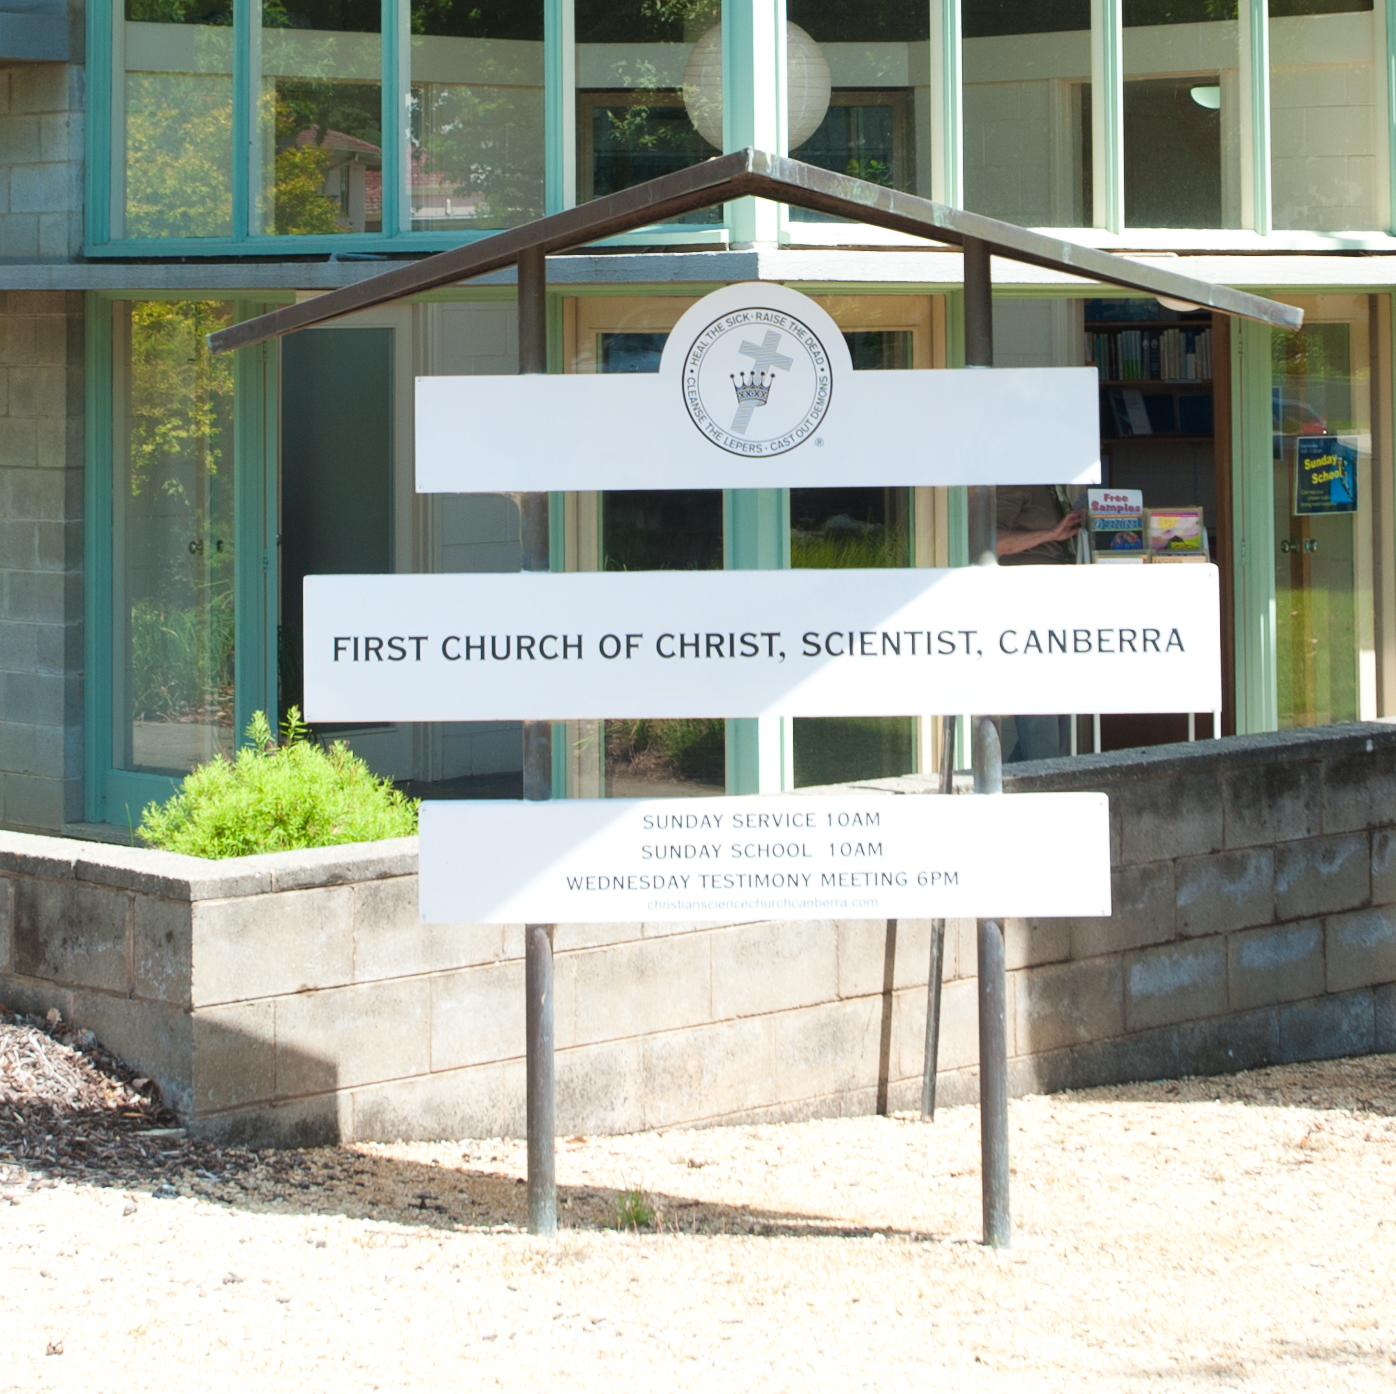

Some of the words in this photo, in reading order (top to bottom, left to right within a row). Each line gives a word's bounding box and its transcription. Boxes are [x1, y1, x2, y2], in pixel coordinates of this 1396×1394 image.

[690, 341, 709, 366] HEAL
[705, 322, 725, 341] THE
[725, 312, 750, 327] SICK
[755, 312, 787, 327] RAISE
[789, 321, 808, 340] THE
[804, 336, 824, 366] DEAD
[686, 376, 707, 424] CLEANSE
[705, 422, 726, 442] THE
[723, 435, 763, 453] LEPERS
[770, 434, 795, 451] CAST
[795, 419, 814, 438] OUT
[811, 375, 828, 420] DEMONS
[1304, 454, 1338, 470] Sunday
[1311, 466, 1343, 484] School
[1091, 500, 1141, 513] Samples
[1103, 493, 1129, 502] Free
[333, 635, 429, 662] FIRST
[441, 634, 583, 662] CHURCH
[598, 633, 643, 660] OF
[655, 632, 786, 663] CHRIST,
[801, 630, 983, 661] SCIENTIST,
[999, 628, 1186, 655] CANBERRA
[643, 814, 723, 830] SUNDAY
[732, 813, 817, 829] SERVICE
[827, 812, 881, 827] 10AM
[641, 844, 722, 860] SUNDAY
[731, 843, 813, 859] SCHOOL
[829, 842, 883, 857] 10AM
[566, 874, 690, 891] WEDNESDAY
[698, 873, 812, 889] TESTIMONY
[821, 871, 908, 888] MEETING
[917, 870, 960, 886] 6PM
[647, 897, 879, 910] christiansciencechurchcanberra.com
